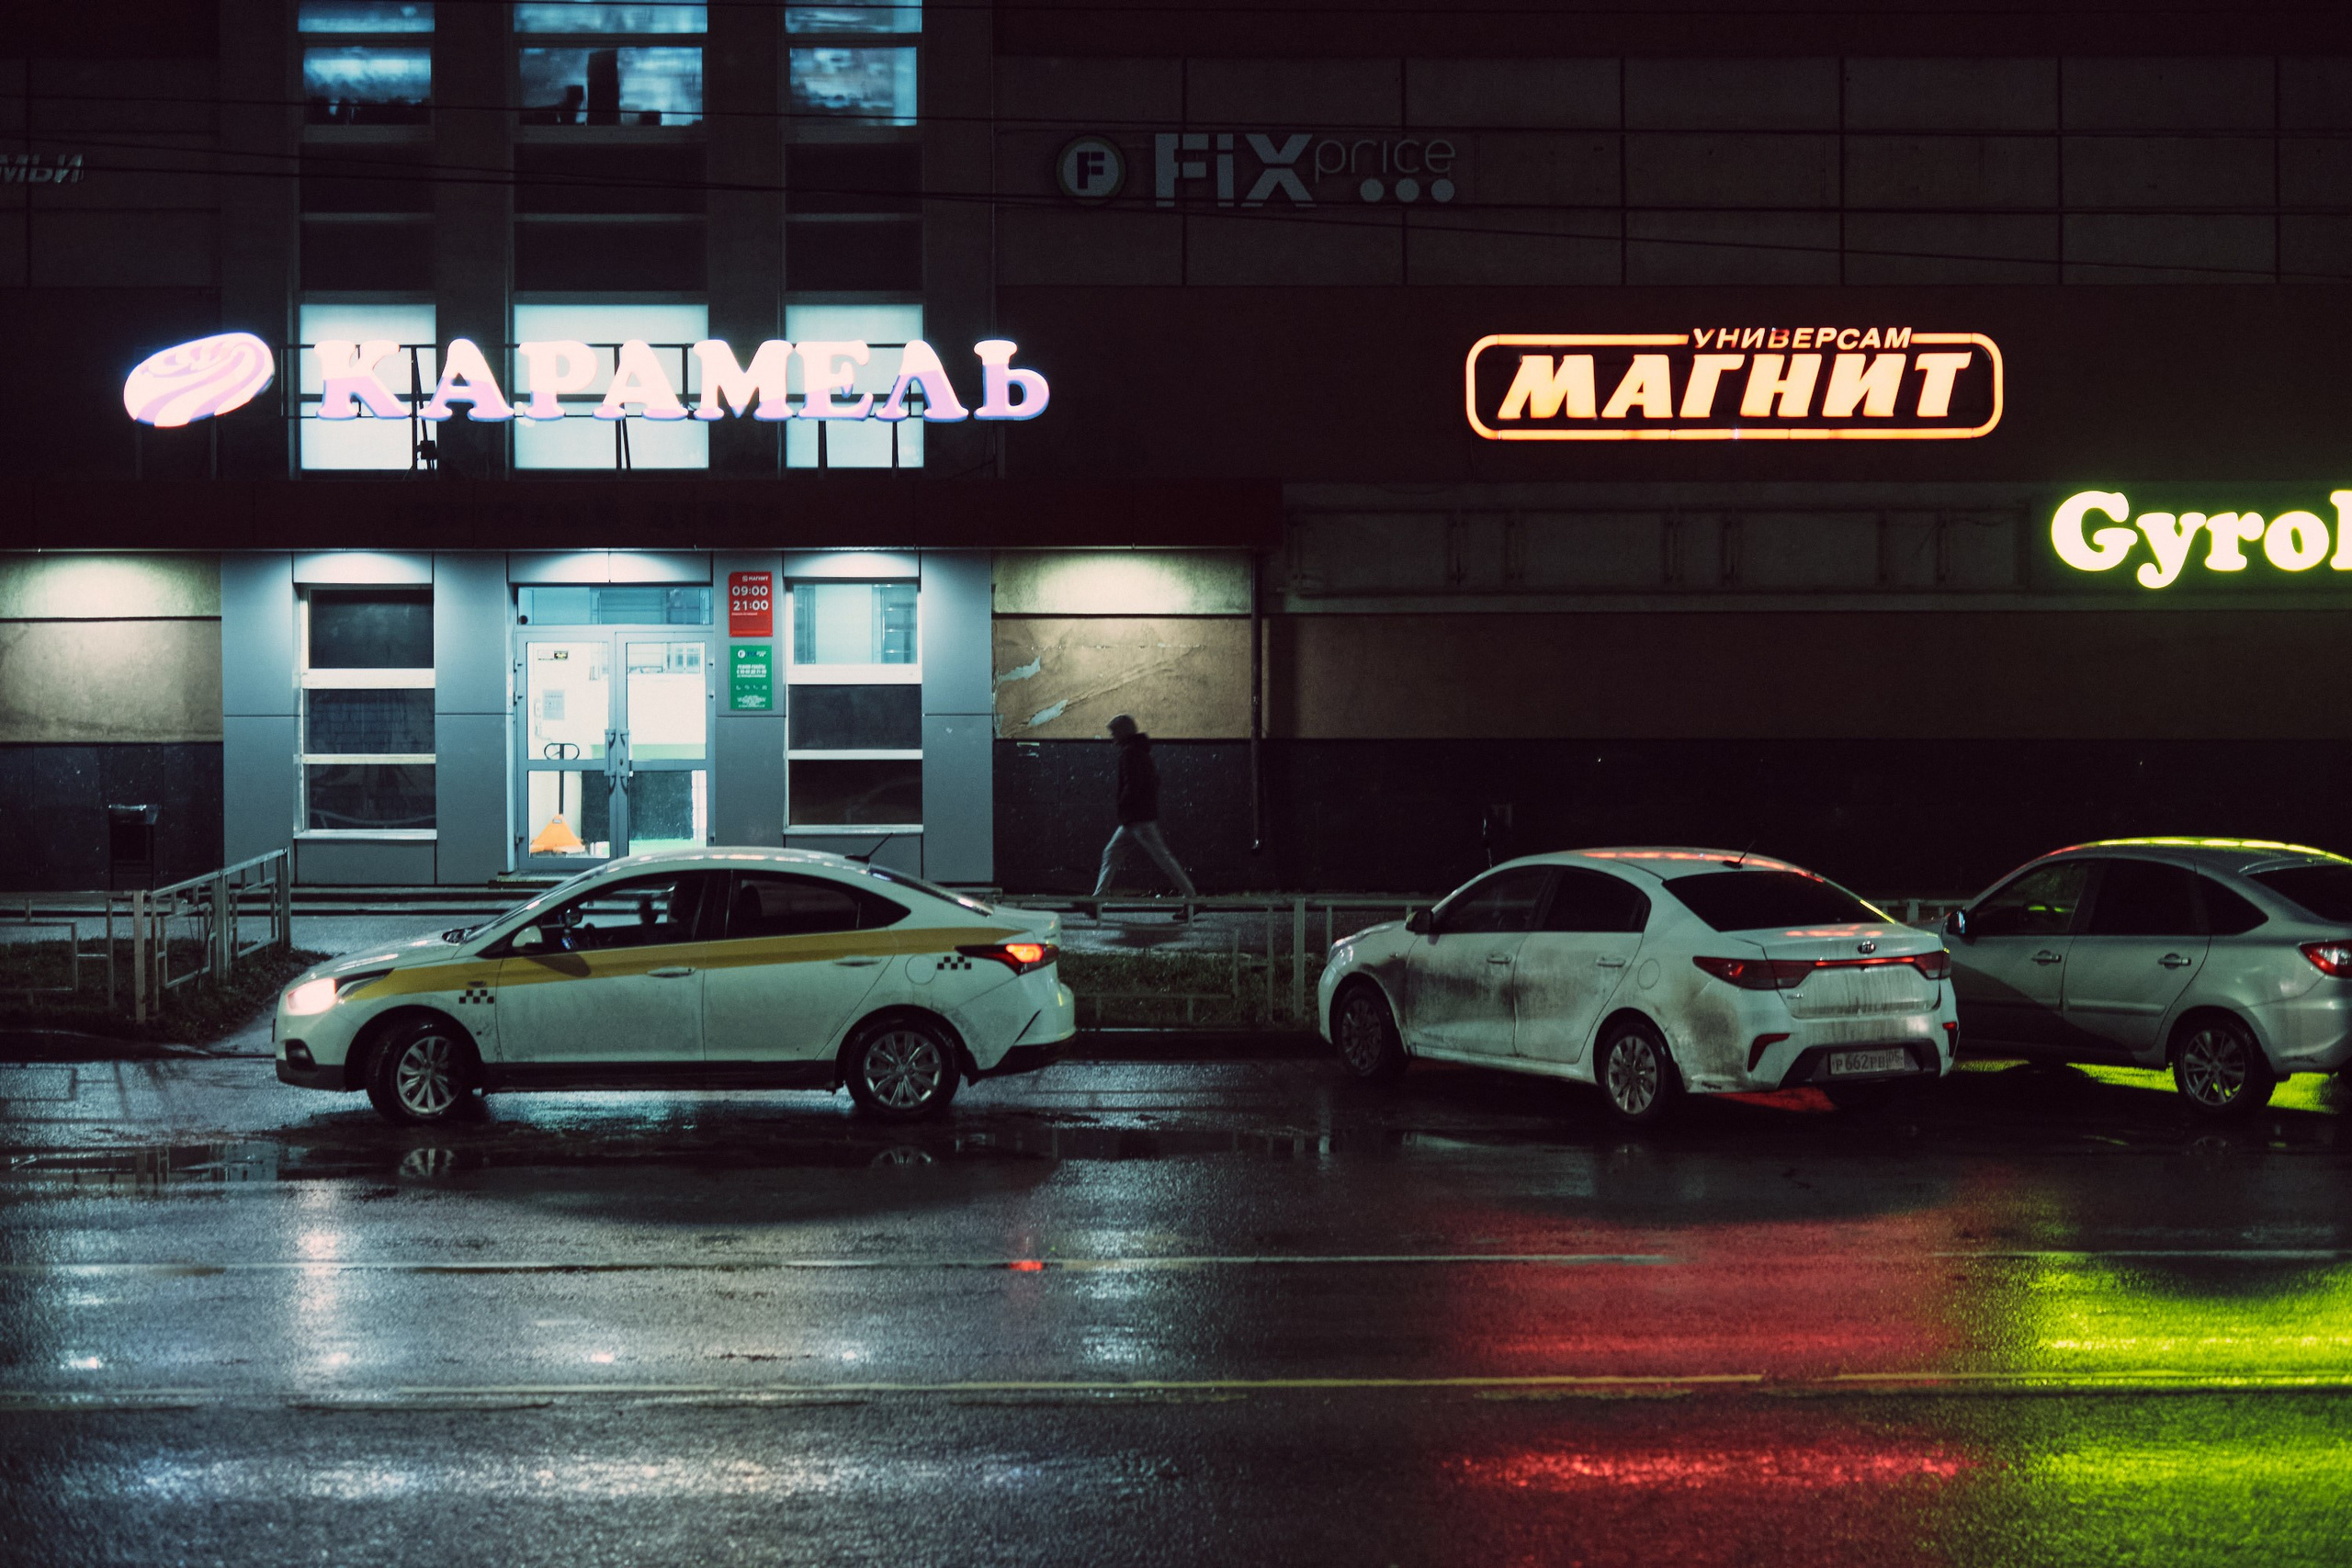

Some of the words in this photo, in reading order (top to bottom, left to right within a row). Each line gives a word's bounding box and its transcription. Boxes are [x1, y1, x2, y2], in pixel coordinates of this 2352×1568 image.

[1315, 139, 1456, 183] price
[1692, 327, 1912, 349] УНИВЕРСАМ
[313, 337, 1050, 423] КАРАМЕЛЬ
[1498, 352, 1972, 419] МАГНИТ
[732, 585, 768, 597] 09:00
[733, 600, 769, 611] 21:00
